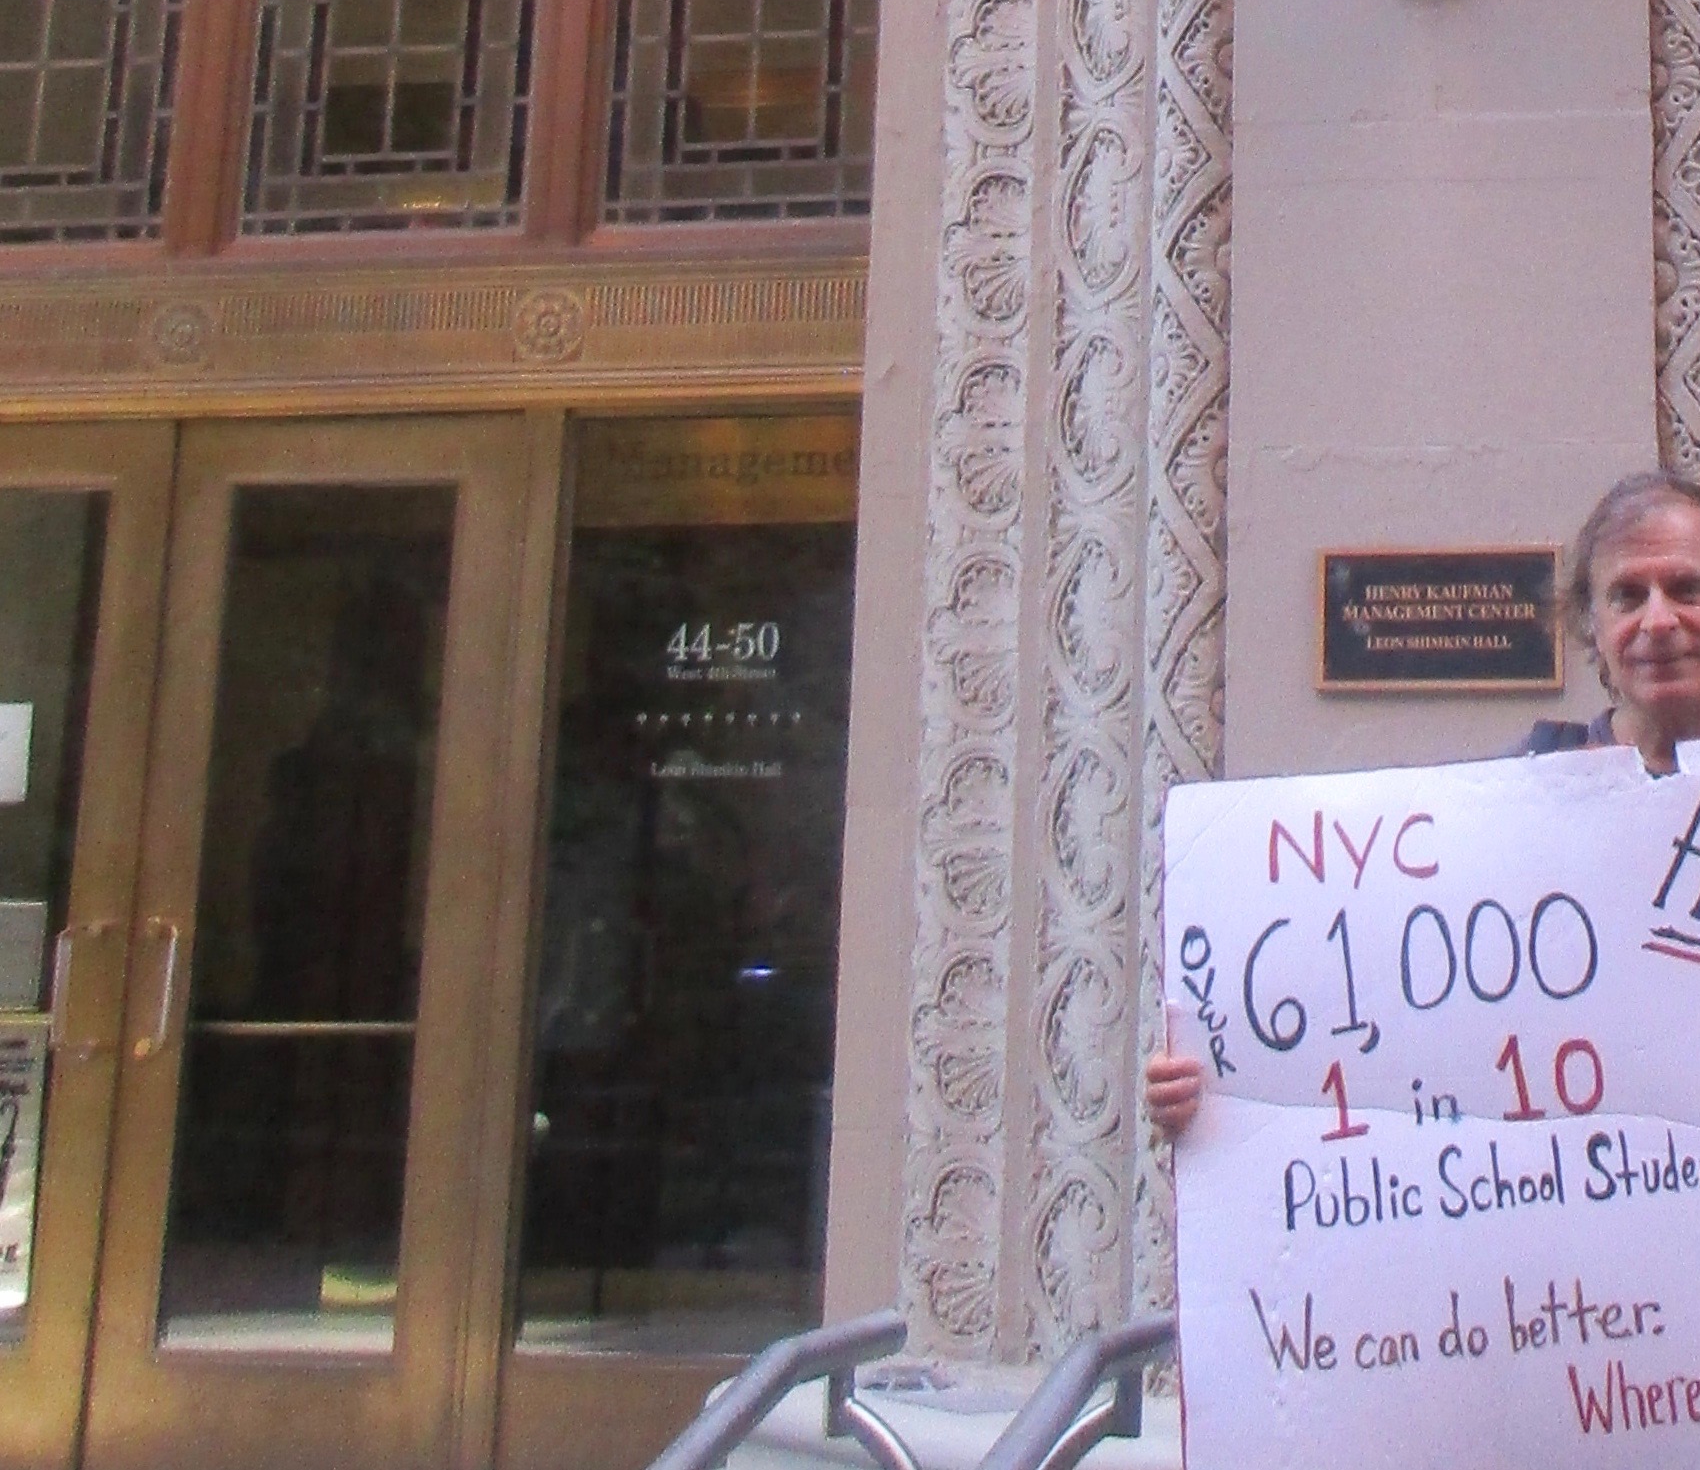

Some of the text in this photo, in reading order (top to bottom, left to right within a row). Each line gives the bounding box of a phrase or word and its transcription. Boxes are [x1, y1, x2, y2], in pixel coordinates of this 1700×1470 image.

[1343, 603, 1536, 621] MANAGEMENT CENTER
[1365, 583, 1513, 601] HENRY KAUFMAN
[667, 622, 781, 662] 44-50
[1473, 634, 1512, 649] HALL
[1268, 810, 1440, 890] NYC
[1180, 925, 1237, 1078] OVER
[1243, 891, 1599, 1054] 61,000
[1320, 1033, 1603, 1142] 1 in 10
[1283, 1155, 1424, 1231] Public
[1438, 1133, 1566, 1220] School
[1249, 1274, 1667, 1372] We can do better.
